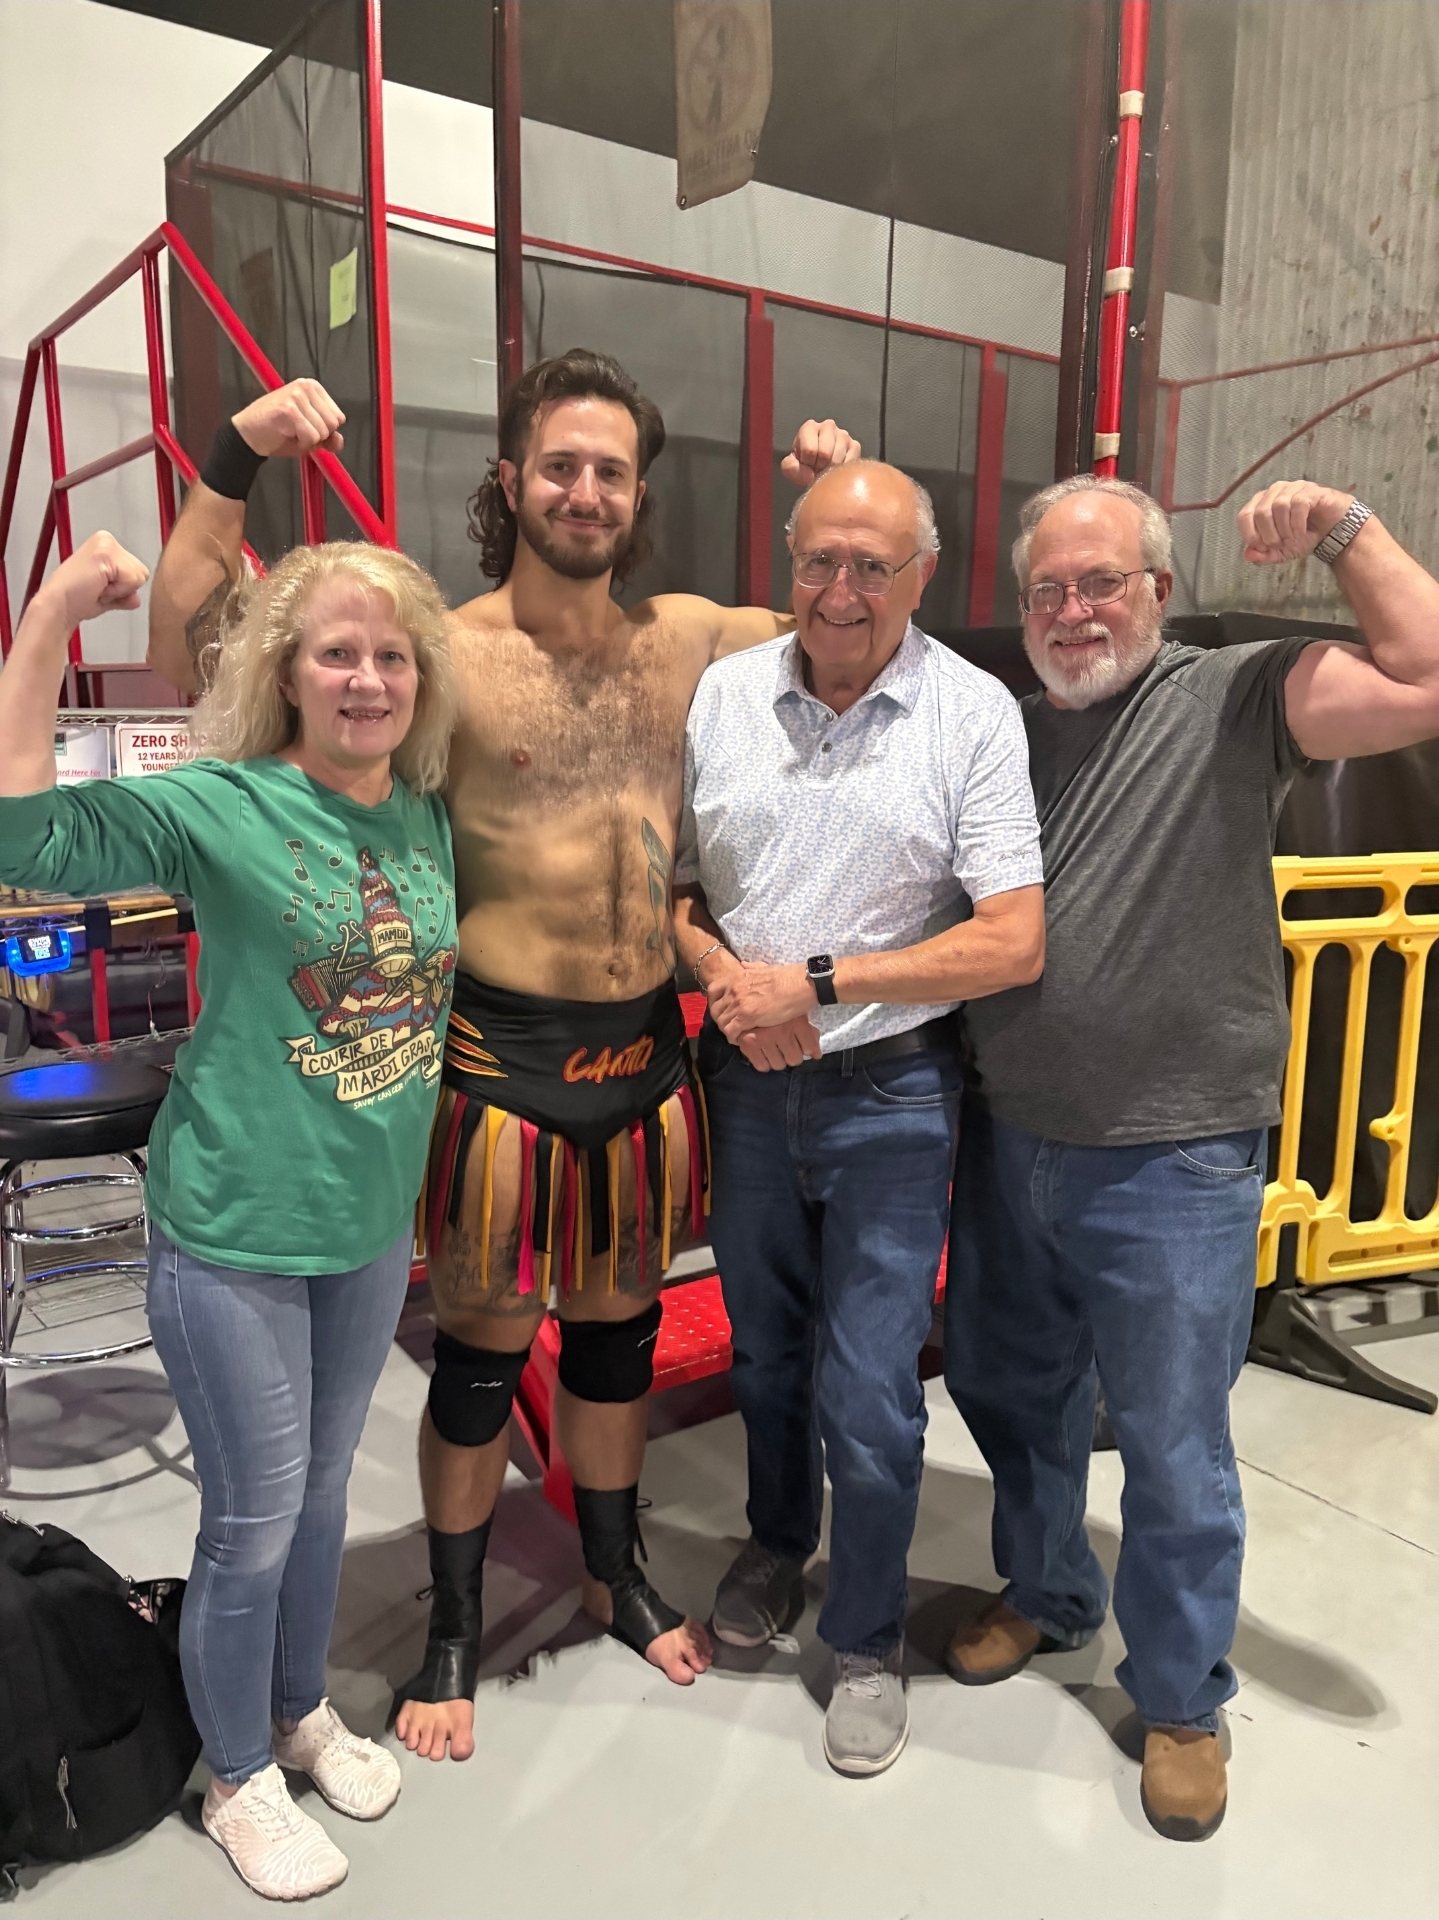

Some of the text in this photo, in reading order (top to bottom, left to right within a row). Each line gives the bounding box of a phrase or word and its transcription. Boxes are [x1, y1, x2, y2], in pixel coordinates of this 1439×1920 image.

[132, 735, 167, 748] ZERO
[138, 752, 148, 761] 12
[149, 752, 177, 761] YEARS
[308, 1033, 388, 1074] COURIR DE
[342, 1057, 401, 1095] MARDI
[401, 1036, 432, 1068] GRAS
